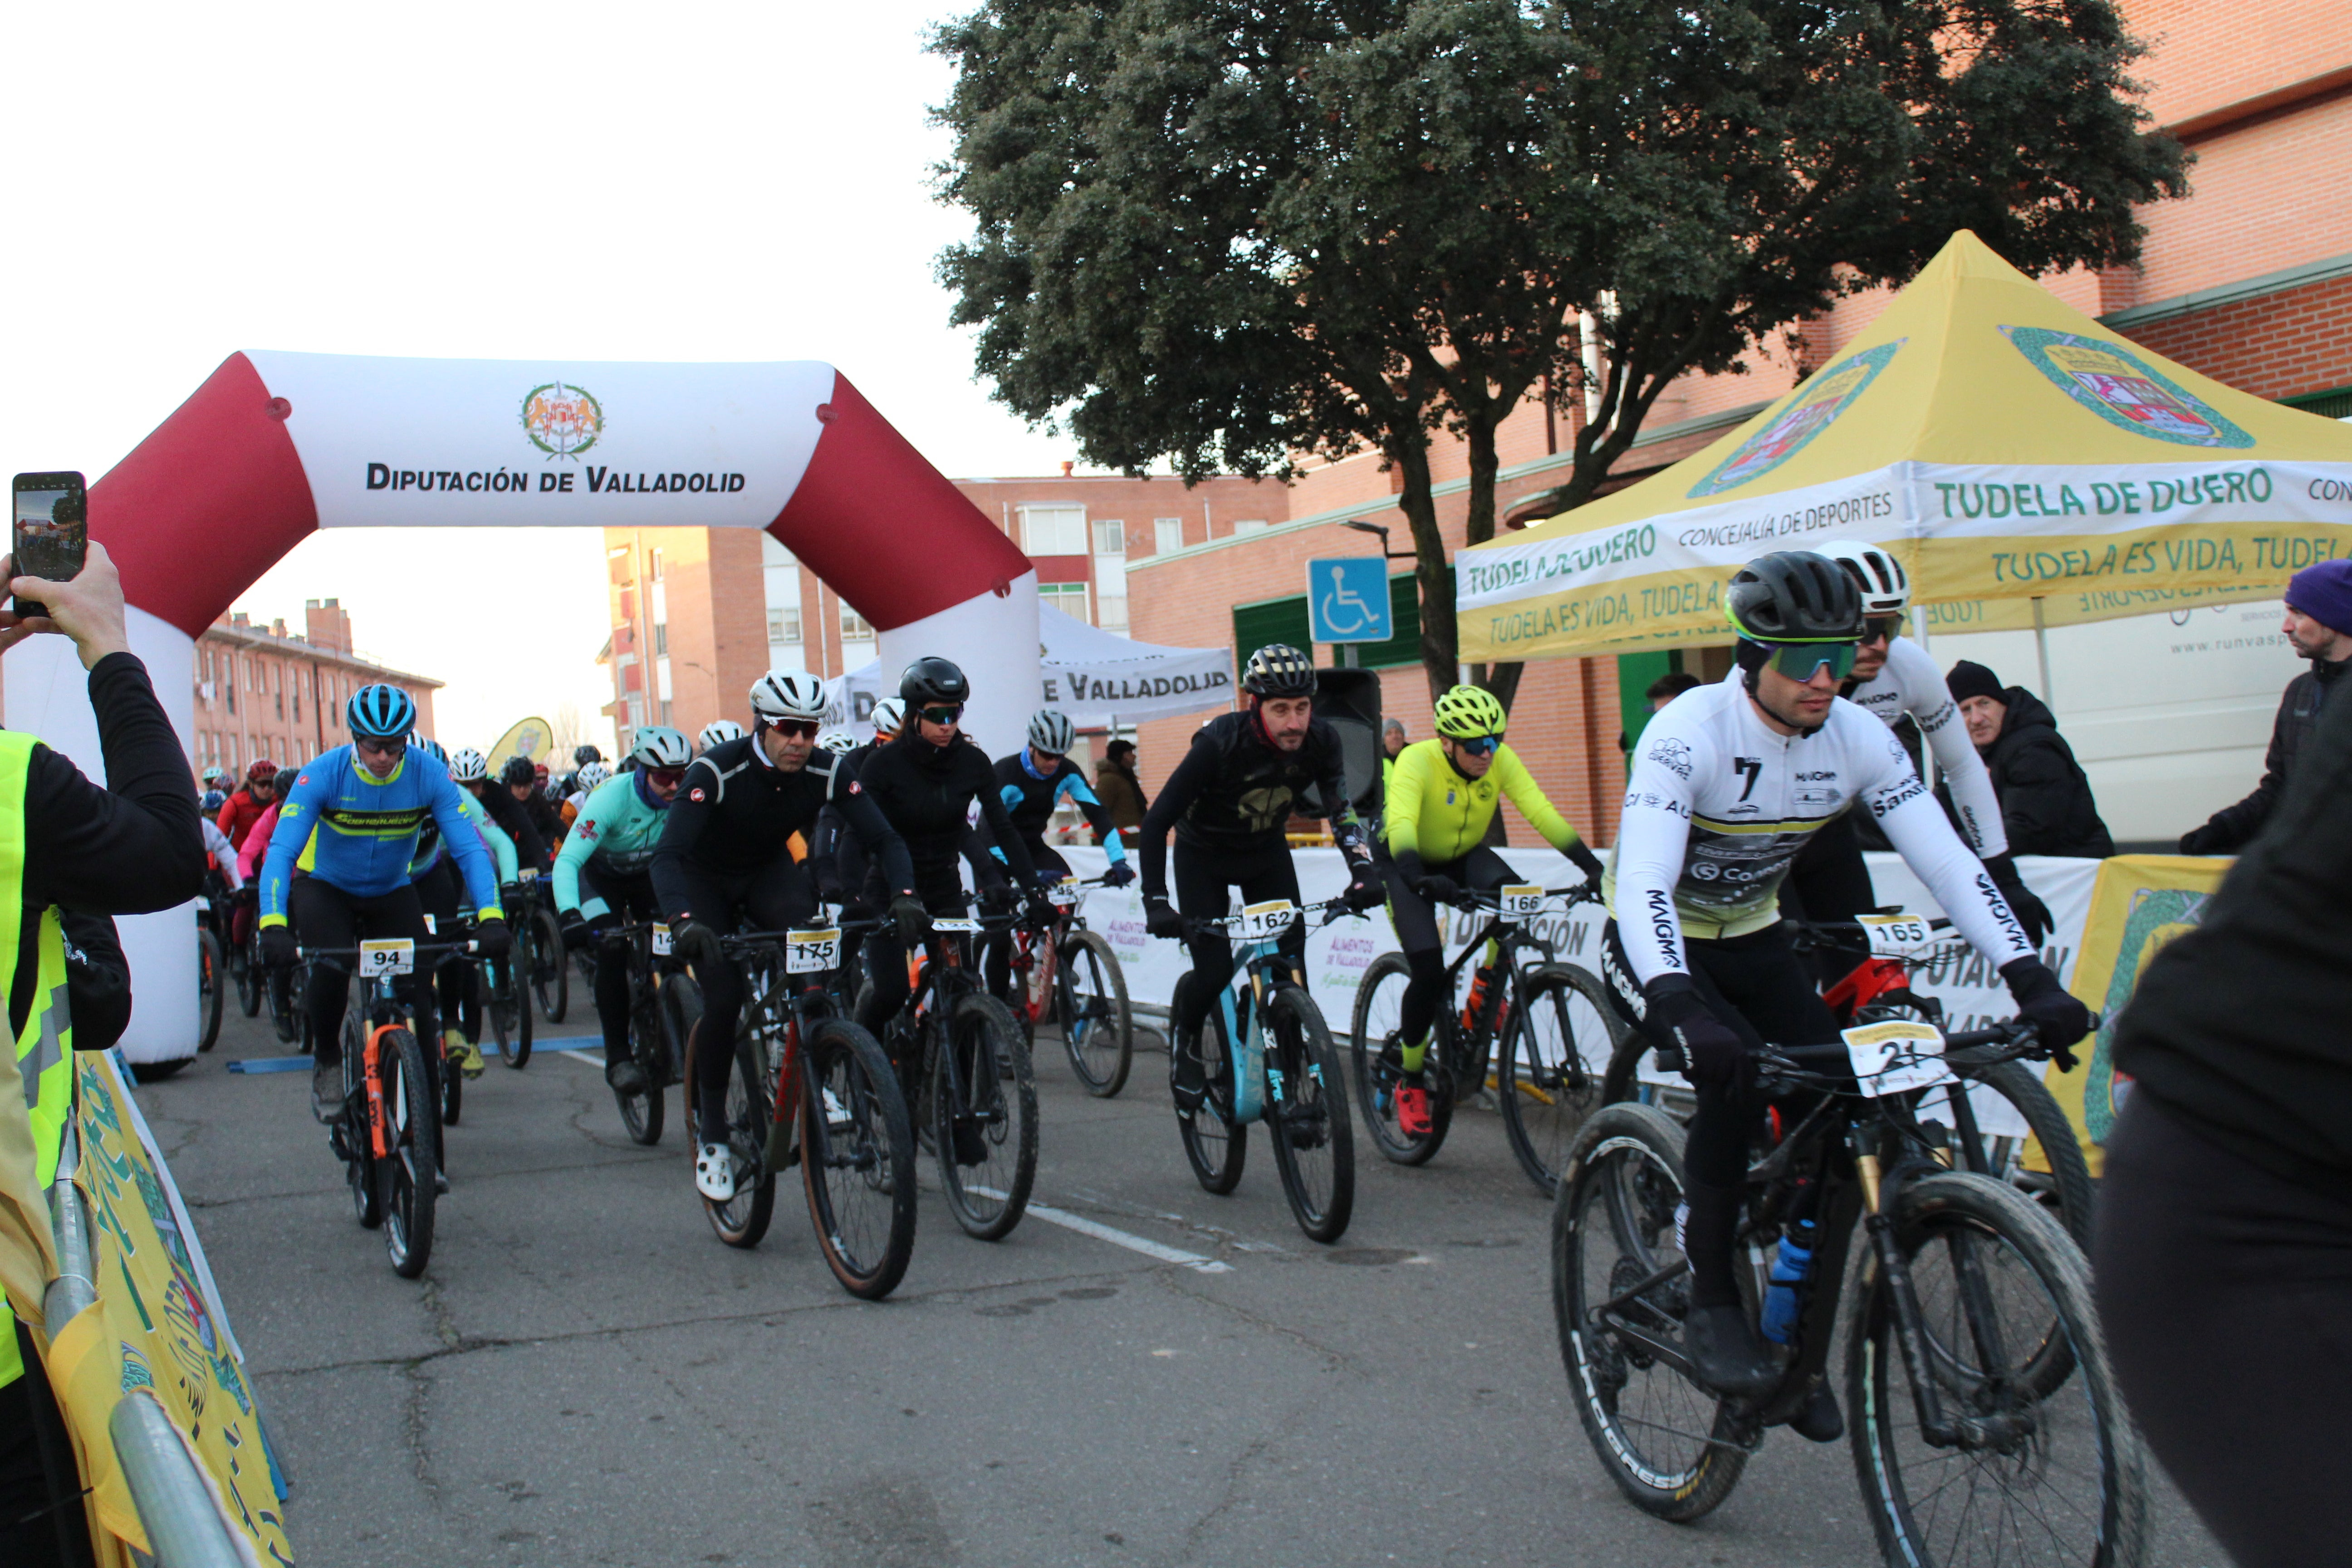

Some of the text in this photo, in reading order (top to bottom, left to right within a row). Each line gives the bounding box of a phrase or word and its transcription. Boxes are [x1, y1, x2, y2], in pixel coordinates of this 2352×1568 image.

[367, 463, 745, 492] DIPUTACIÓN DE VALLADOLID
[1934, 467, 2272, 518] TUDELA DE DUERO
[1679, 492, 1891, 546] CONCEJALÍA DE DEPORTES
[1992, 537, 2352, 582] TUDELA ES VIDA, TUDEL
[1490, 607, 1557, 644] TUDELA
[1559, 603, 1580, 632] ES
[1585, 593, 1634, 627] VIDA,
[1640, 580, 1720, 618] TUDELA
[1043, 671, 1228, 702] E VALLADOLID
[1508, 896, 1540, 911] 166
[1252, 911, 1290, 931] 162
[1875, 922, 1924, 942] 165
[373, 951, 400, 965] 94
[797, 941, 833, 960] 175
[1879, 1041, 1920, 1071] 21
